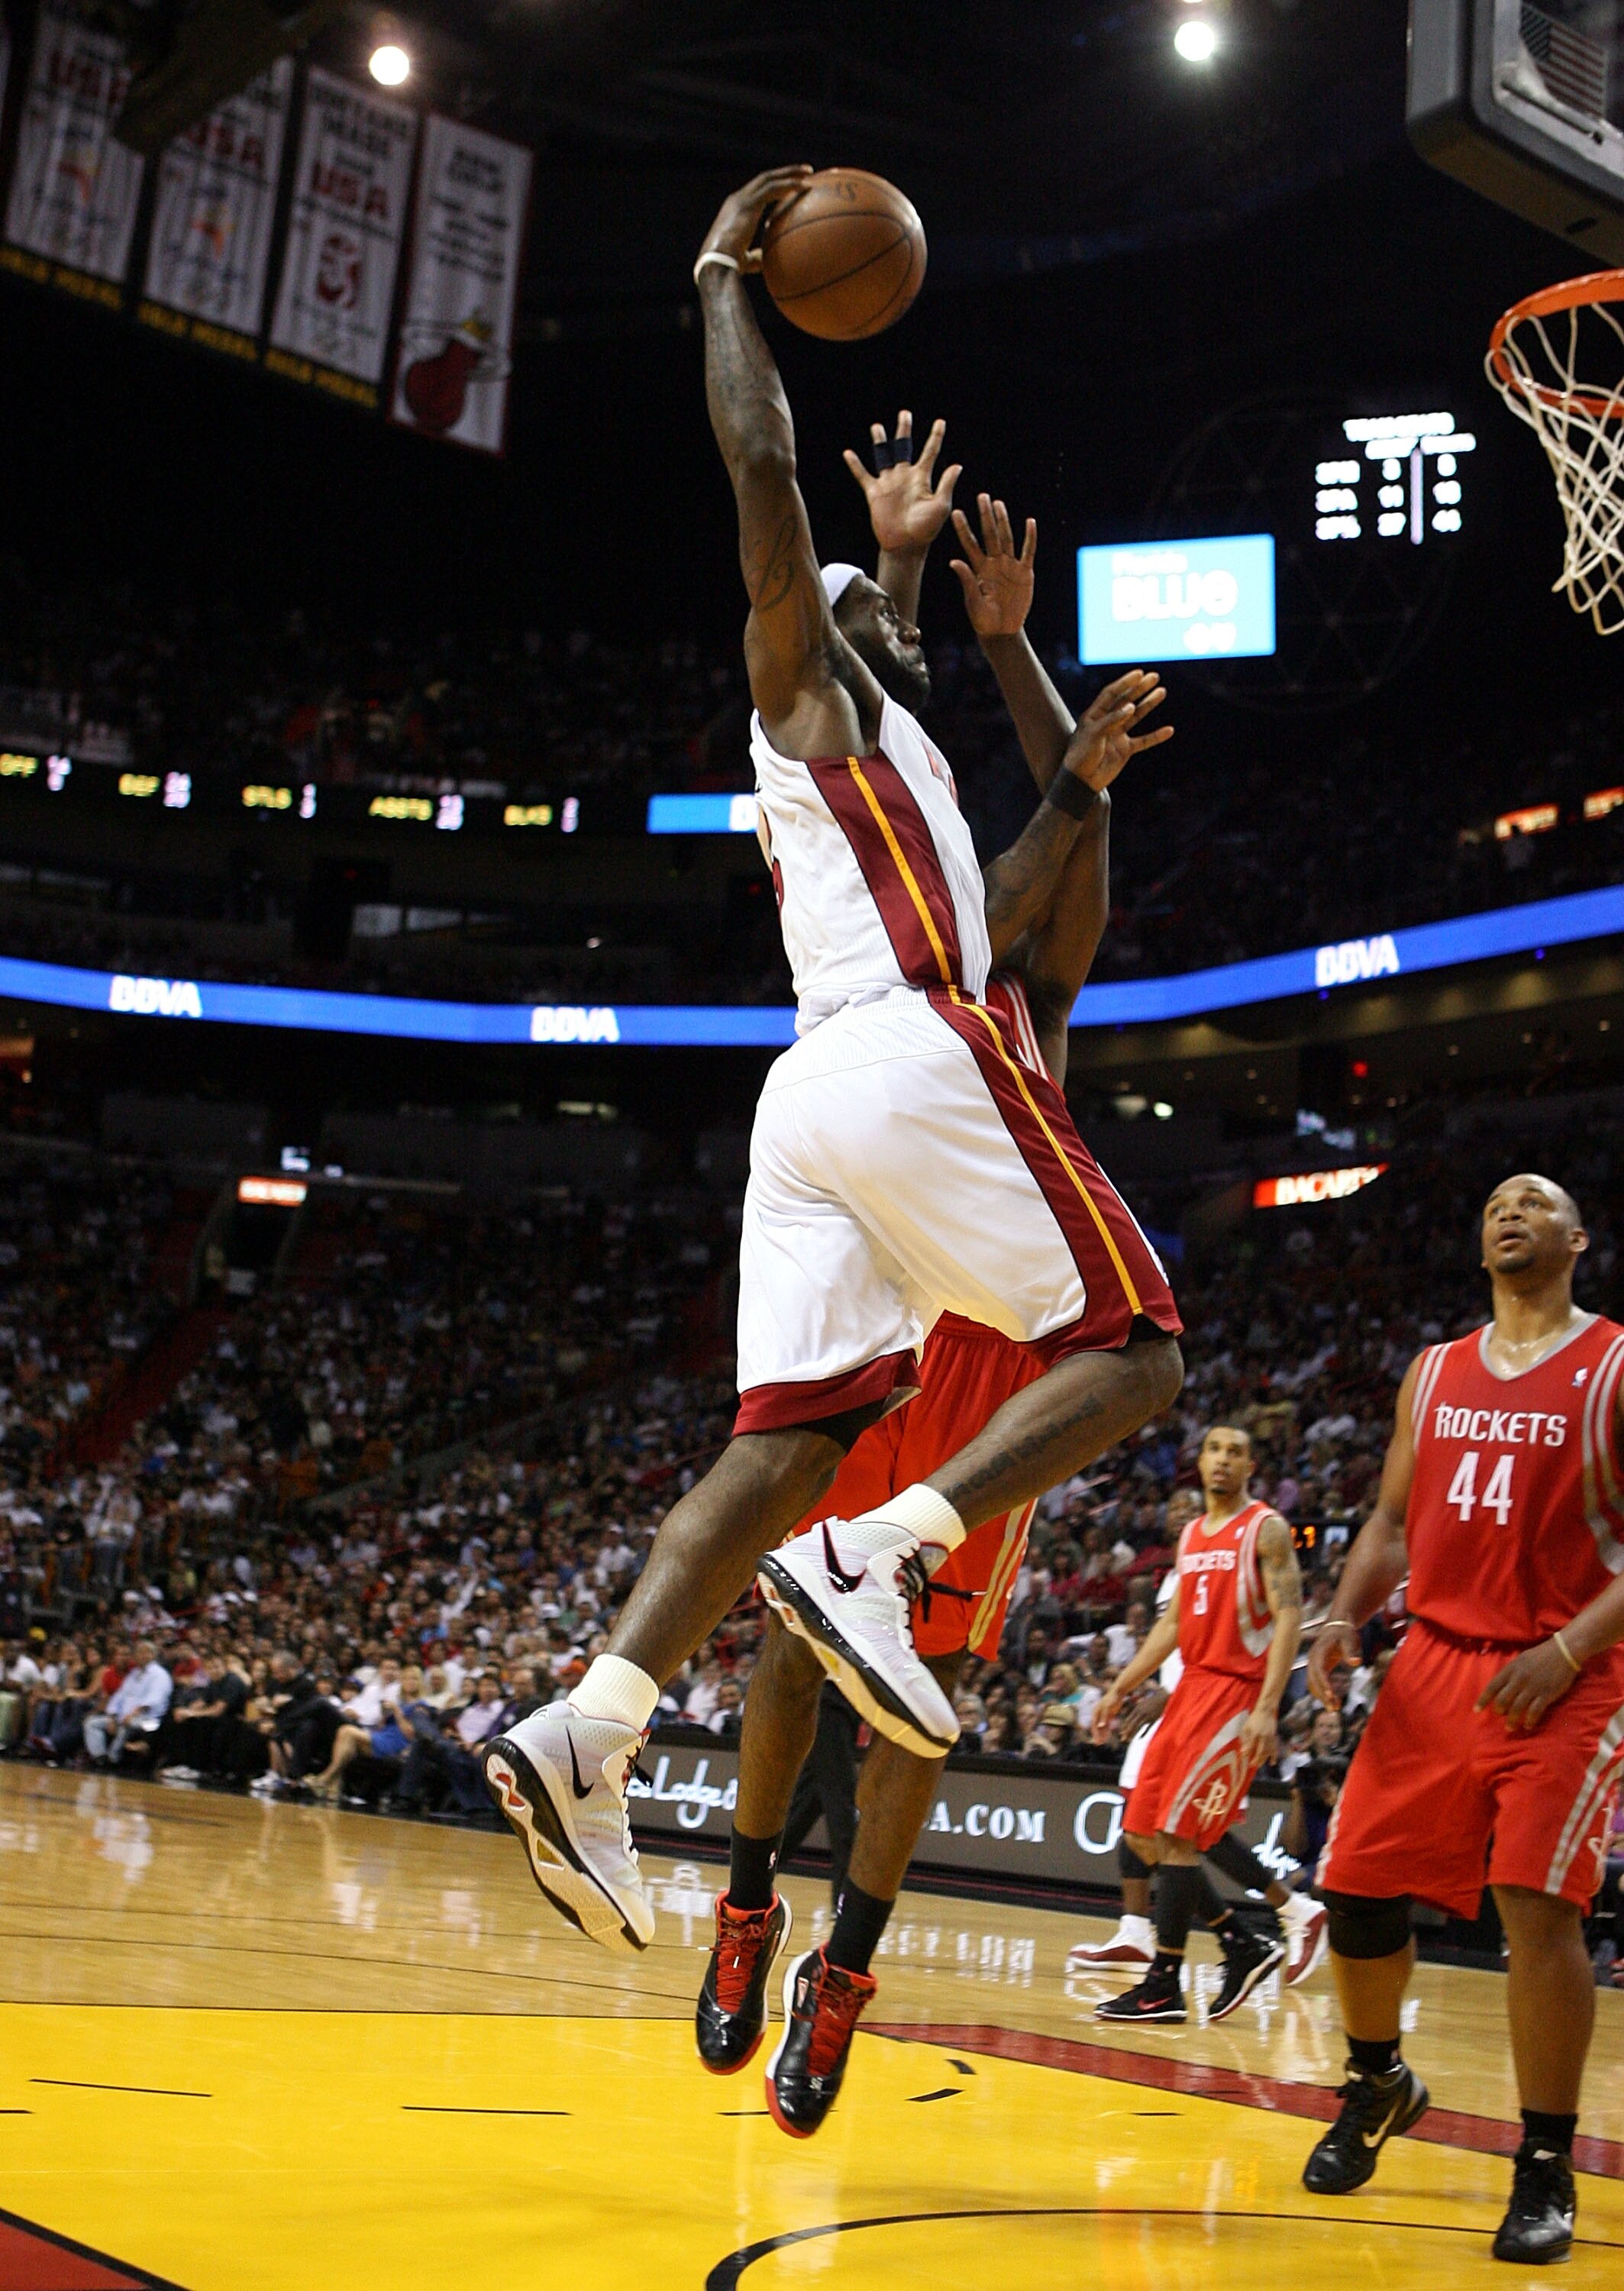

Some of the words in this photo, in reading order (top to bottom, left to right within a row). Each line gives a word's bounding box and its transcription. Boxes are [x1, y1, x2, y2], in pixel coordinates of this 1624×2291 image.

[1315, 934, 1400, 987] BBVA
[109, 974, 203, 1018] BBVA
[531, 1006, 620, 1043] BBVA
[1434, 1401, 1568, 1447] ROCKETS
[1446, 1450, 1516, 1526] 44
[1193, 1574, 1209, 1616] 5
[653, 1755, 722, 1829] Lodge
[922, 1800, 1046, 1843] A.COM
